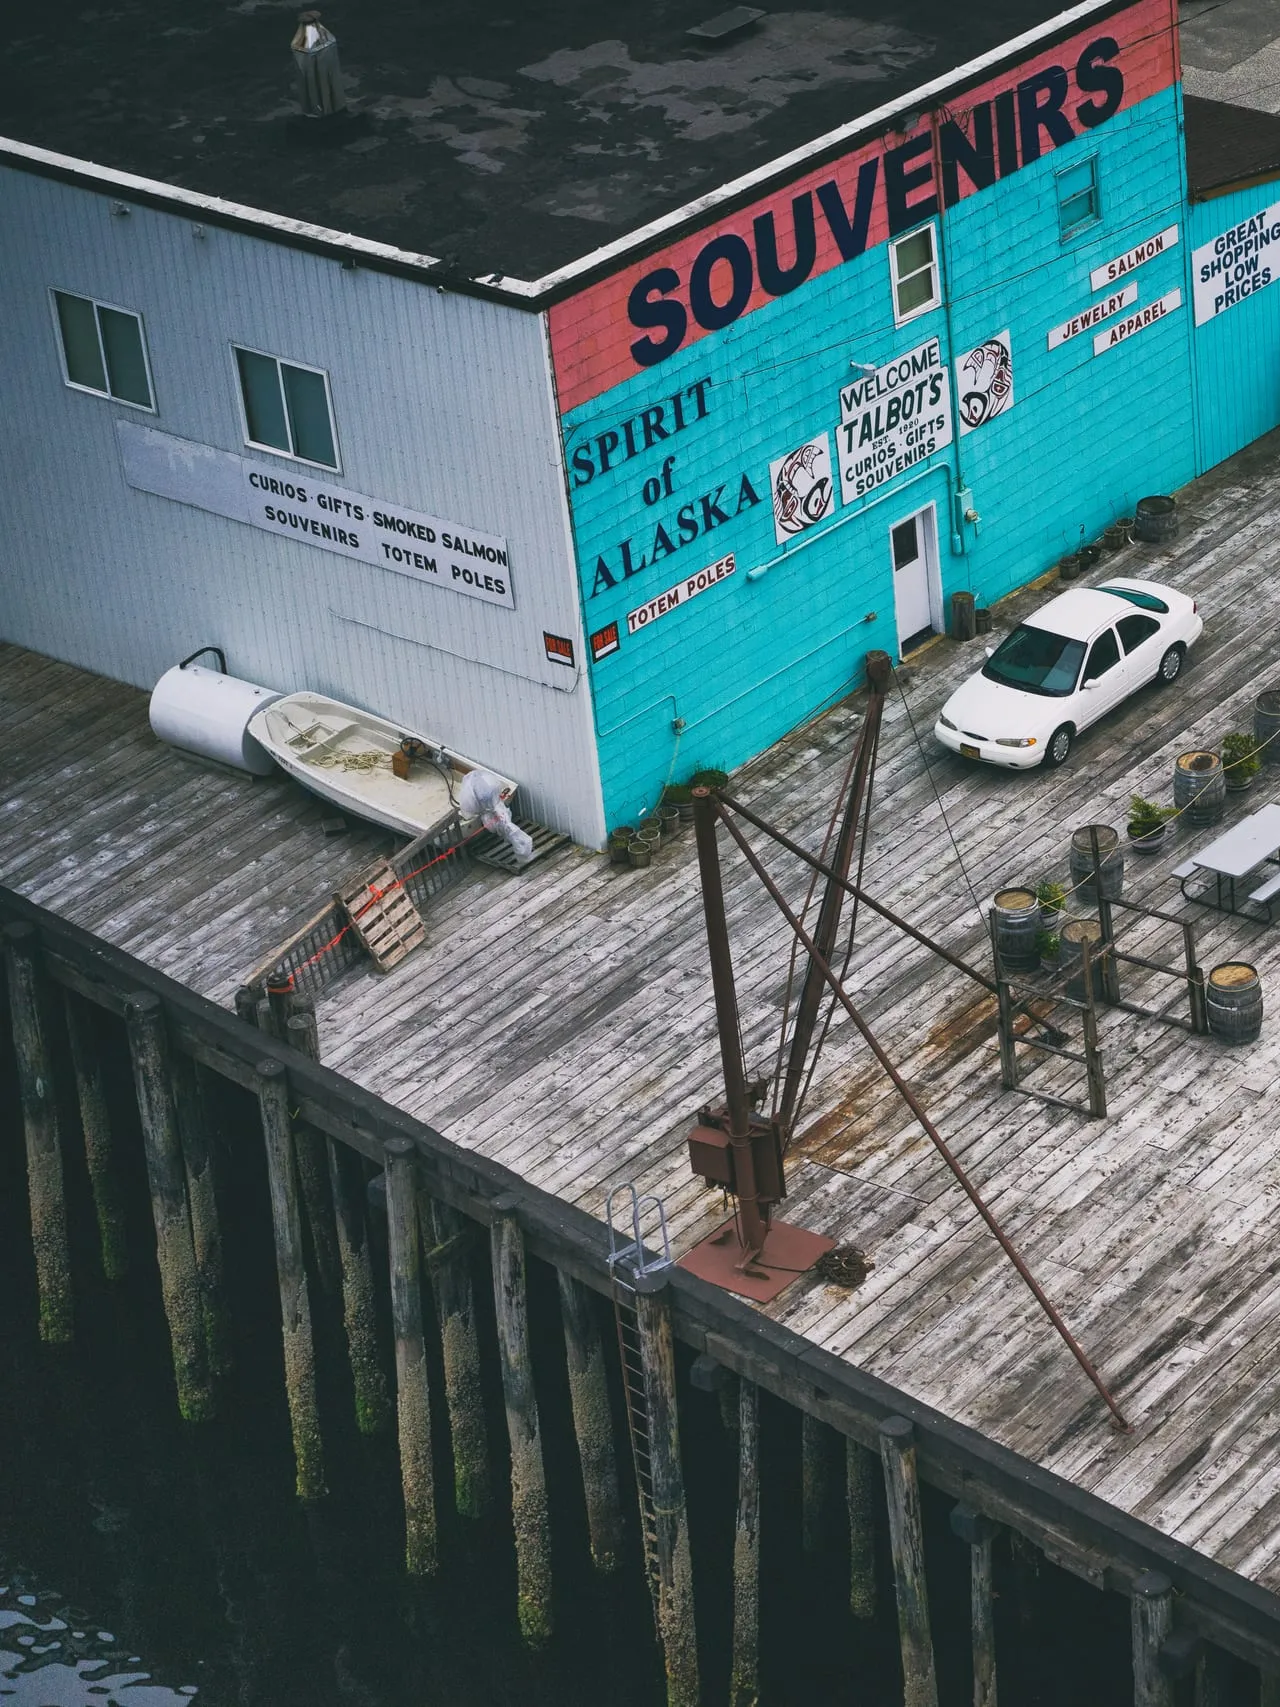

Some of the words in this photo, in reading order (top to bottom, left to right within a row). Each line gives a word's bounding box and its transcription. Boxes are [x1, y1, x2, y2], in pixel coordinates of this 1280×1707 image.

[627, 36, 1125, 367] SOUVENIRS
[1214, 211, 1267, 255] GREAT
[1107, 236, 1164, 280] SALMON
[1224, 254, 1260, 289] LOW
[1063, 292, 1125, 340] JEWELRY
[1214, 267, 1271, 314] PRICES
[1109, 301, 1166, 346] APPAREL
[841, 342, 939, 413] WELCOME
[571, 377, 713, 488] SPIRIT
[843, 371, 943, 454] TALBOT'S
[872, 435, 890, 450] EST.
[899, 417, 919, 436] 1920
[642, 455, 676, 506] of
[845, 442, 896, 483] CURIOS
[905, 414, 945, 448] GIFTS
[856, 437, 936, 496] SOUVENIRS
[249, 472, 307, 502] CURIOS
[317, 494, 364, 521] GIFTS
[373, 511, 436, 543] SMOKED
[442, 533, 507, 567] SALMON
[264, 506, 359, 548] SOUVENIRS
[382, 542, 437, 573] TOTEM
[451, 564, 506, 595] POLES
[590, 472, 762, 600] ALASKA
[628, 589, 680, 630] TOTEM
[687, 556, 735, 597] POLES
